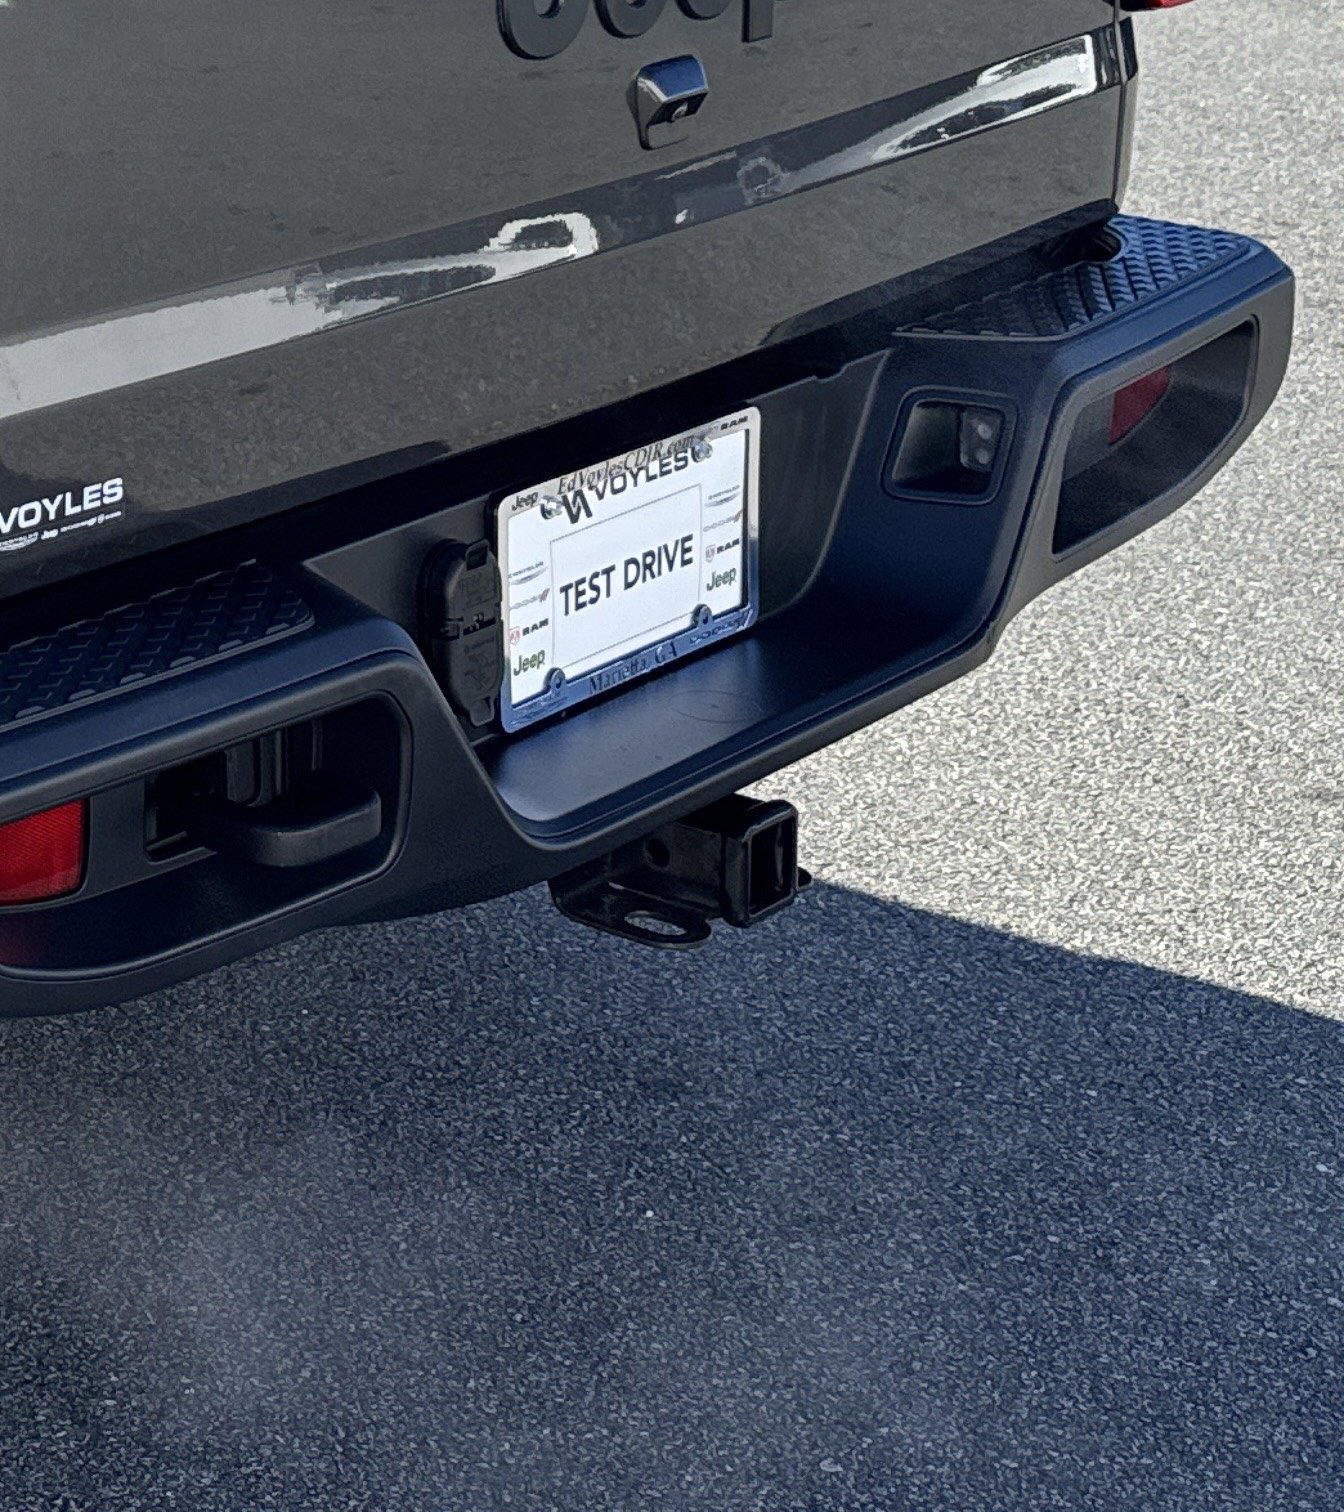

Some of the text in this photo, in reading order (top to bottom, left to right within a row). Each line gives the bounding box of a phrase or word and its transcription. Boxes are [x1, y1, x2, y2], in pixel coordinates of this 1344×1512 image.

[720, 415, 749, 431] RAM
[596, 449, 689, 501] VOYLES
[511, 491, 539, 511] Jeep
[716, 538, 740, 555] RAM
[559, 564, 616, 617] TEST
[623, 534, 694, 591] DRIVE
[706, 567, 737, 592] Jeep
[522, 617, 549, 637] RAM
[513, 648, 546, 676] Jeep
